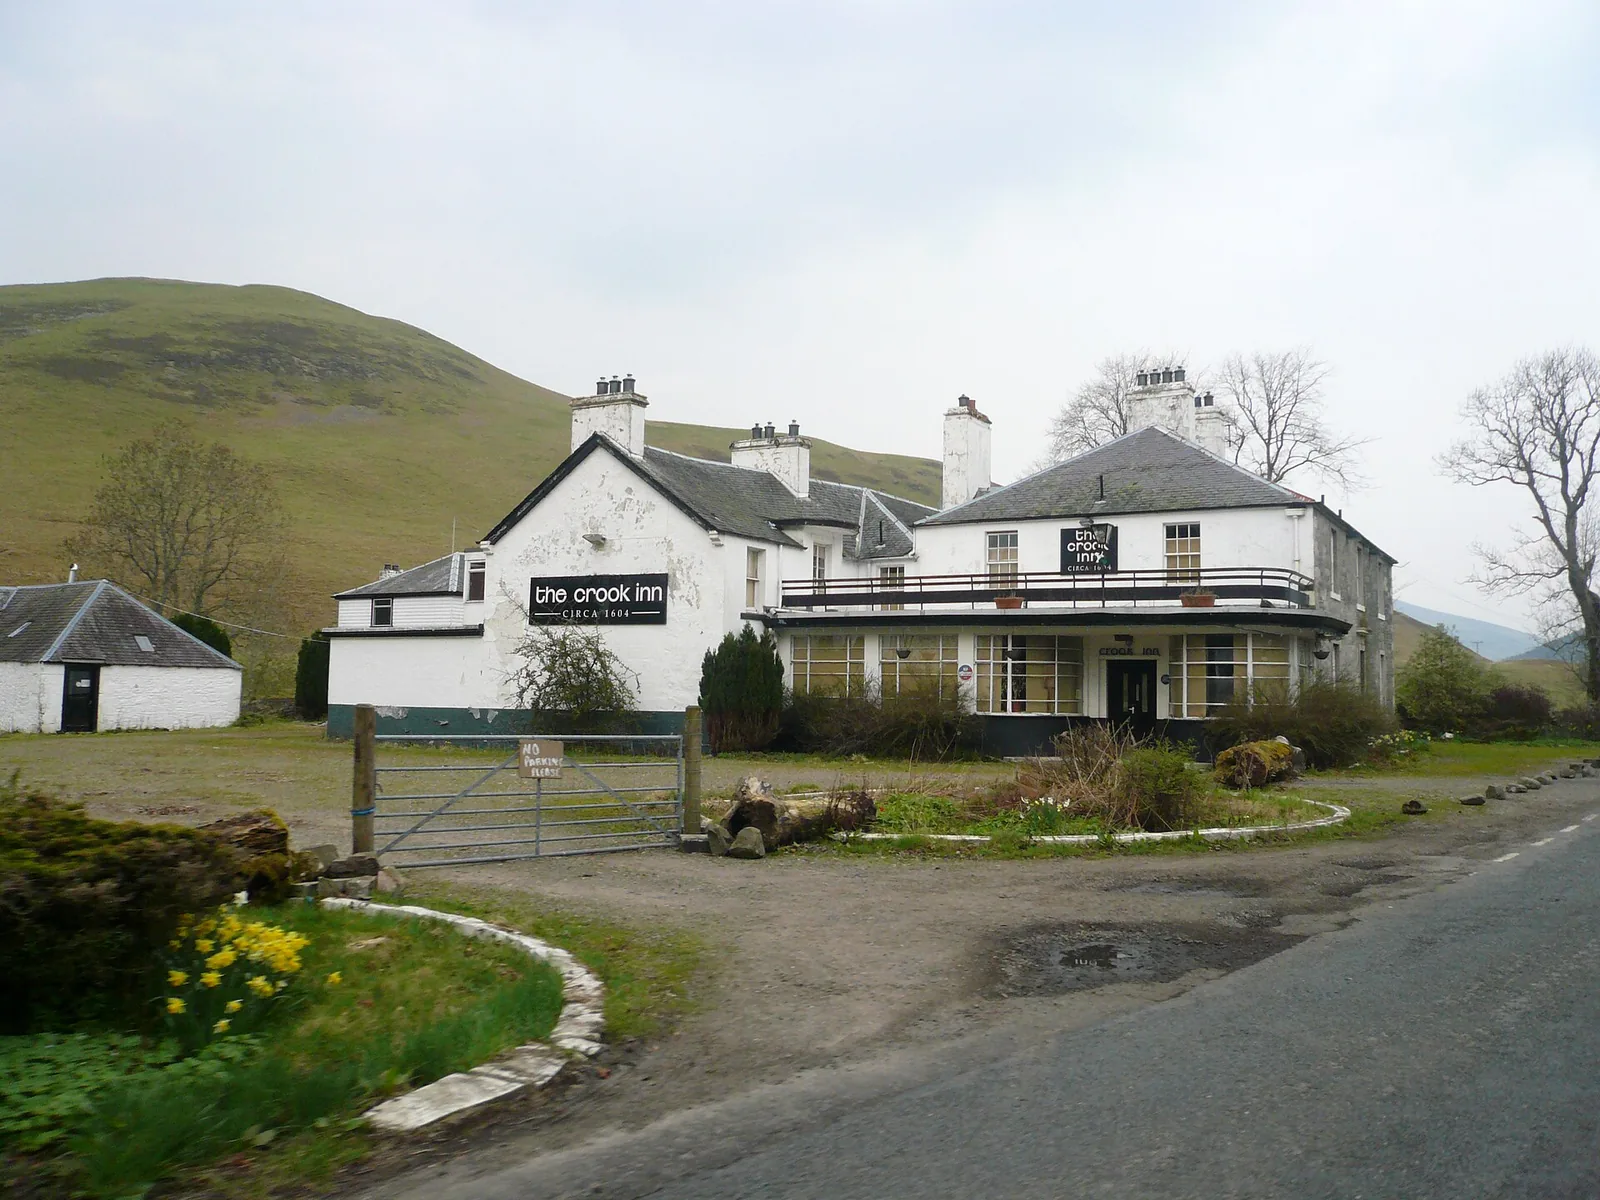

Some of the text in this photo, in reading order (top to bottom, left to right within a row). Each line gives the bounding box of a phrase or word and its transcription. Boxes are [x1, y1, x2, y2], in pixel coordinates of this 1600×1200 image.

[1075, 529, 1097, 541] th
[535, 582, 663, 603] the crook inn
[562, 609, 629, 618] CIRCA 1604
[522, 743, 540, 756] NO
